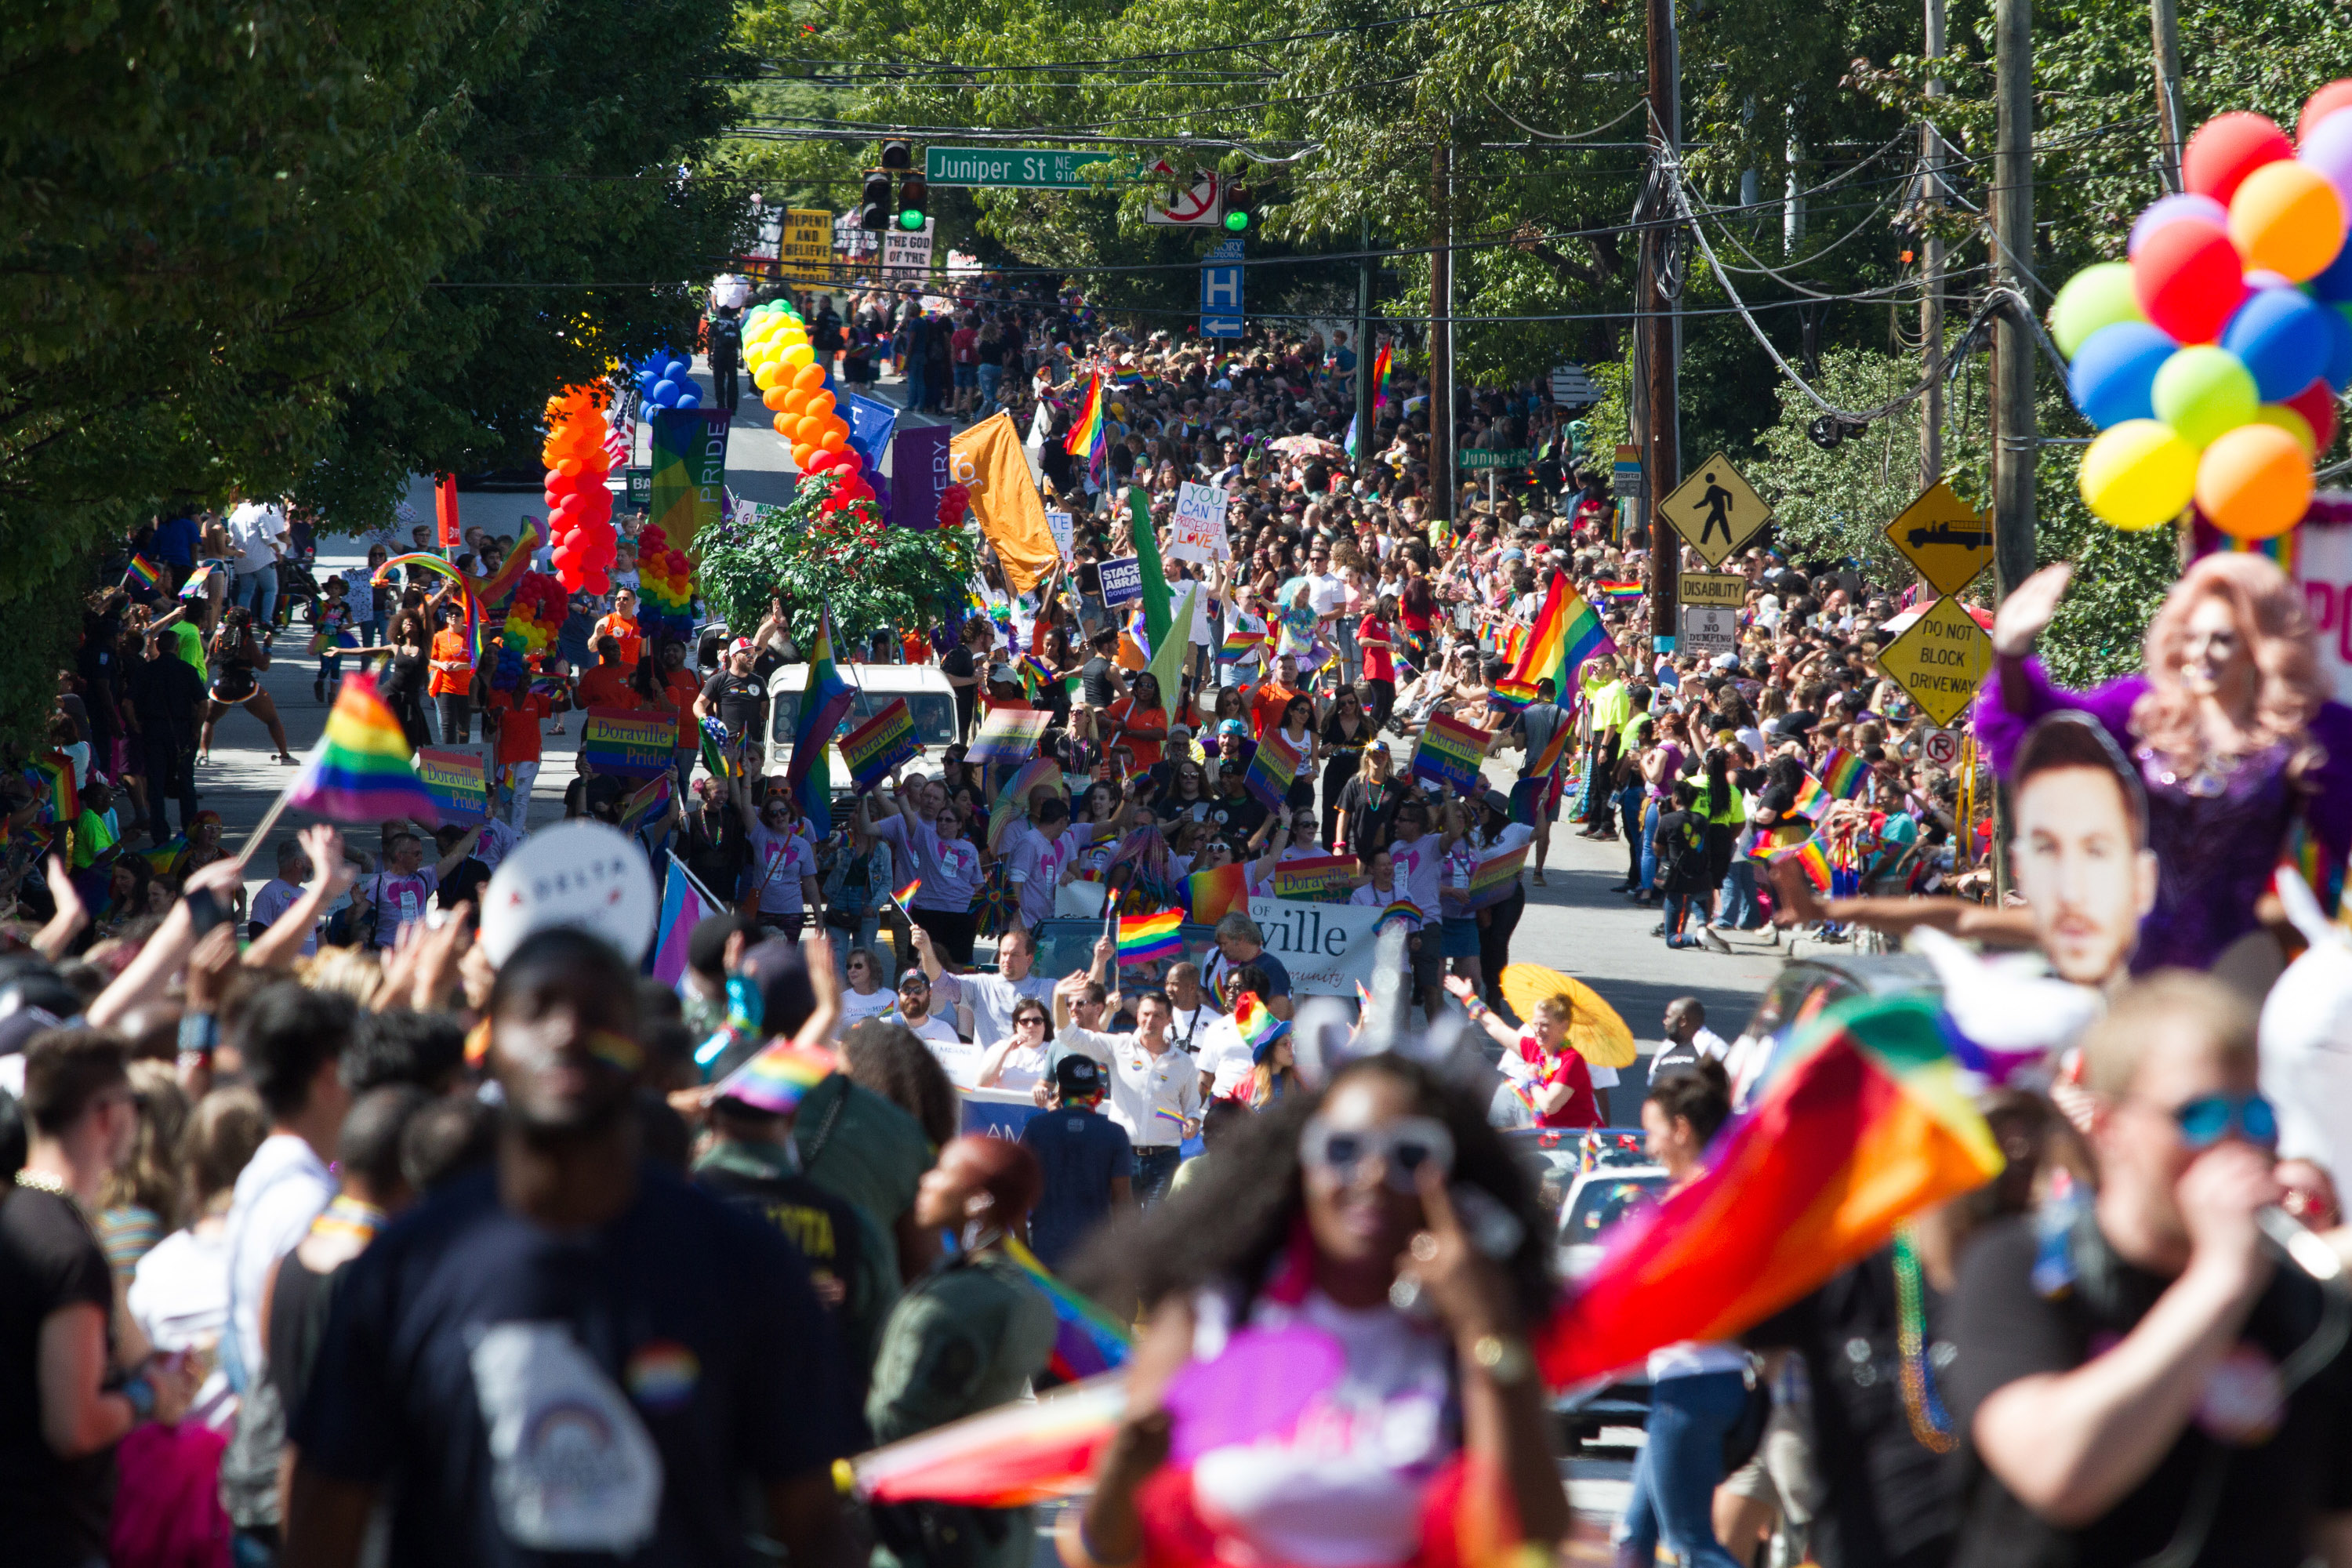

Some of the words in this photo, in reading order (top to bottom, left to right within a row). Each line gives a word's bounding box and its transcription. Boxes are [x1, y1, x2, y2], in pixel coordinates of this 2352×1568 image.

[935, 155, 1012, 183] Juniper
[1023, 157, 1047, 181] St
[1054, 156, 1073, 170] NE
[785, 213, 829, 228] REPENT
[796, 230, 818, 241] AND
[833, 239, 878, 250] JESUS
[887, 236, 907, 248] THE
[909, 237, 930, 249] GOD
[785, 244, 829, 256] BELIEVE
[889, 251, 902, 263] OF
[905, 252, 925, 264] THE
[700, 422, 726, 503] PRIDE
[1462, 450, 1515, 466] Juniper
[1191, 485, 1222, 506] YOU
[1181, 499, 1223, 521] CAN'T
[1047, 515, 1069, 530] TE
[1178, 529, 1214, 549] LOVE
[1102, 563, 1140, 581] STACE
[1107, 586, 1142, 598] GOVERNO
[1684, 581, 1740, 597] DISABILITY
[1689, 633, 1732, 643] DUMPING
[1923, 620, 1943, 637] DO
[1946, 623, 1974, 641] NOT
[1921, 647, 1965, 667] BLOCK
[1910, 672, 1977, 695] DRIVEWAY
[597, 720, 668, 744] Doraville
[848, 717, 906, 764] Doraville
[879, 736, 913, 766] Pride
[1429, 726, 1479, 760] Doraville
[626, 746, 666, 768] Pride
[426, 762, 479, 788] Doraville
[452, 789, 482, 811] Pride
[1252, 904, 1272, 917] OF
[1255, 909, 1347, 957] ville
[1287, 967, 1345, 989] munity
